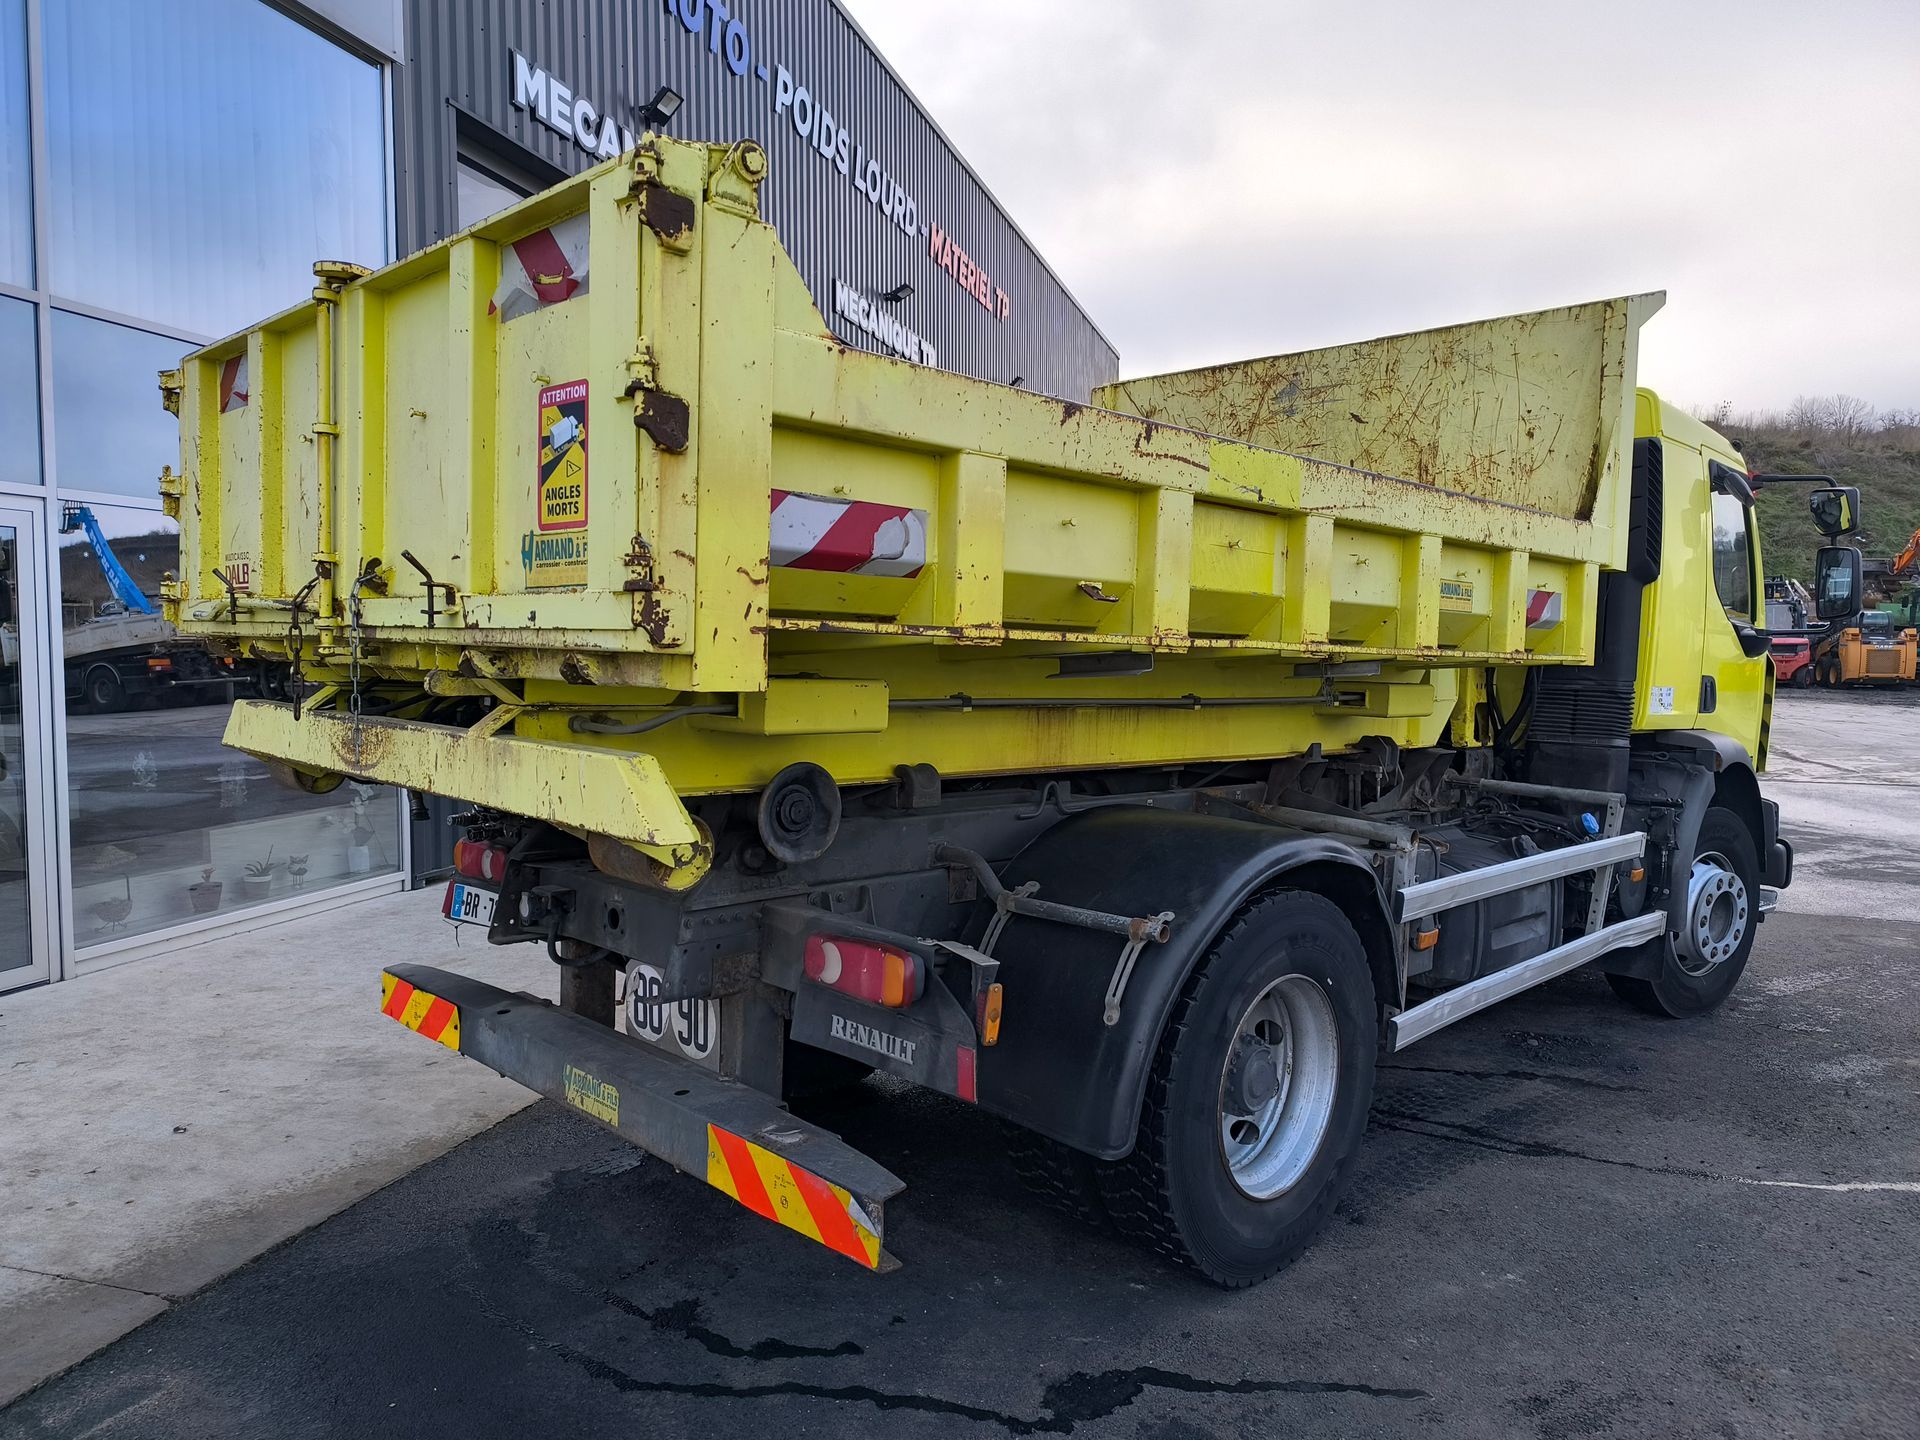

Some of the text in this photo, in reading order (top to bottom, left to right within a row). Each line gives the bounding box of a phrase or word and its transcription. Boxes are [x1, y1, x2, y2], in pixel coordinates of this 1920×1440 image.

[667, 0, 750, 76] UTO
[775, 64, 850, 175] POIDS
[853, 144, 917, 237] LOURD
[929, 222, 993, 313] MATERIEL
[994, 286, 1010, 323] TP
[834, 281, 920, 363] MECANIQUE
[541, 384, 586, 405] ATTENTION
[545, 484, 581, 501] ANGLES
[547, 500, 579, 517] MORTS
[830, 1013, 916, 1066] RENAULT
